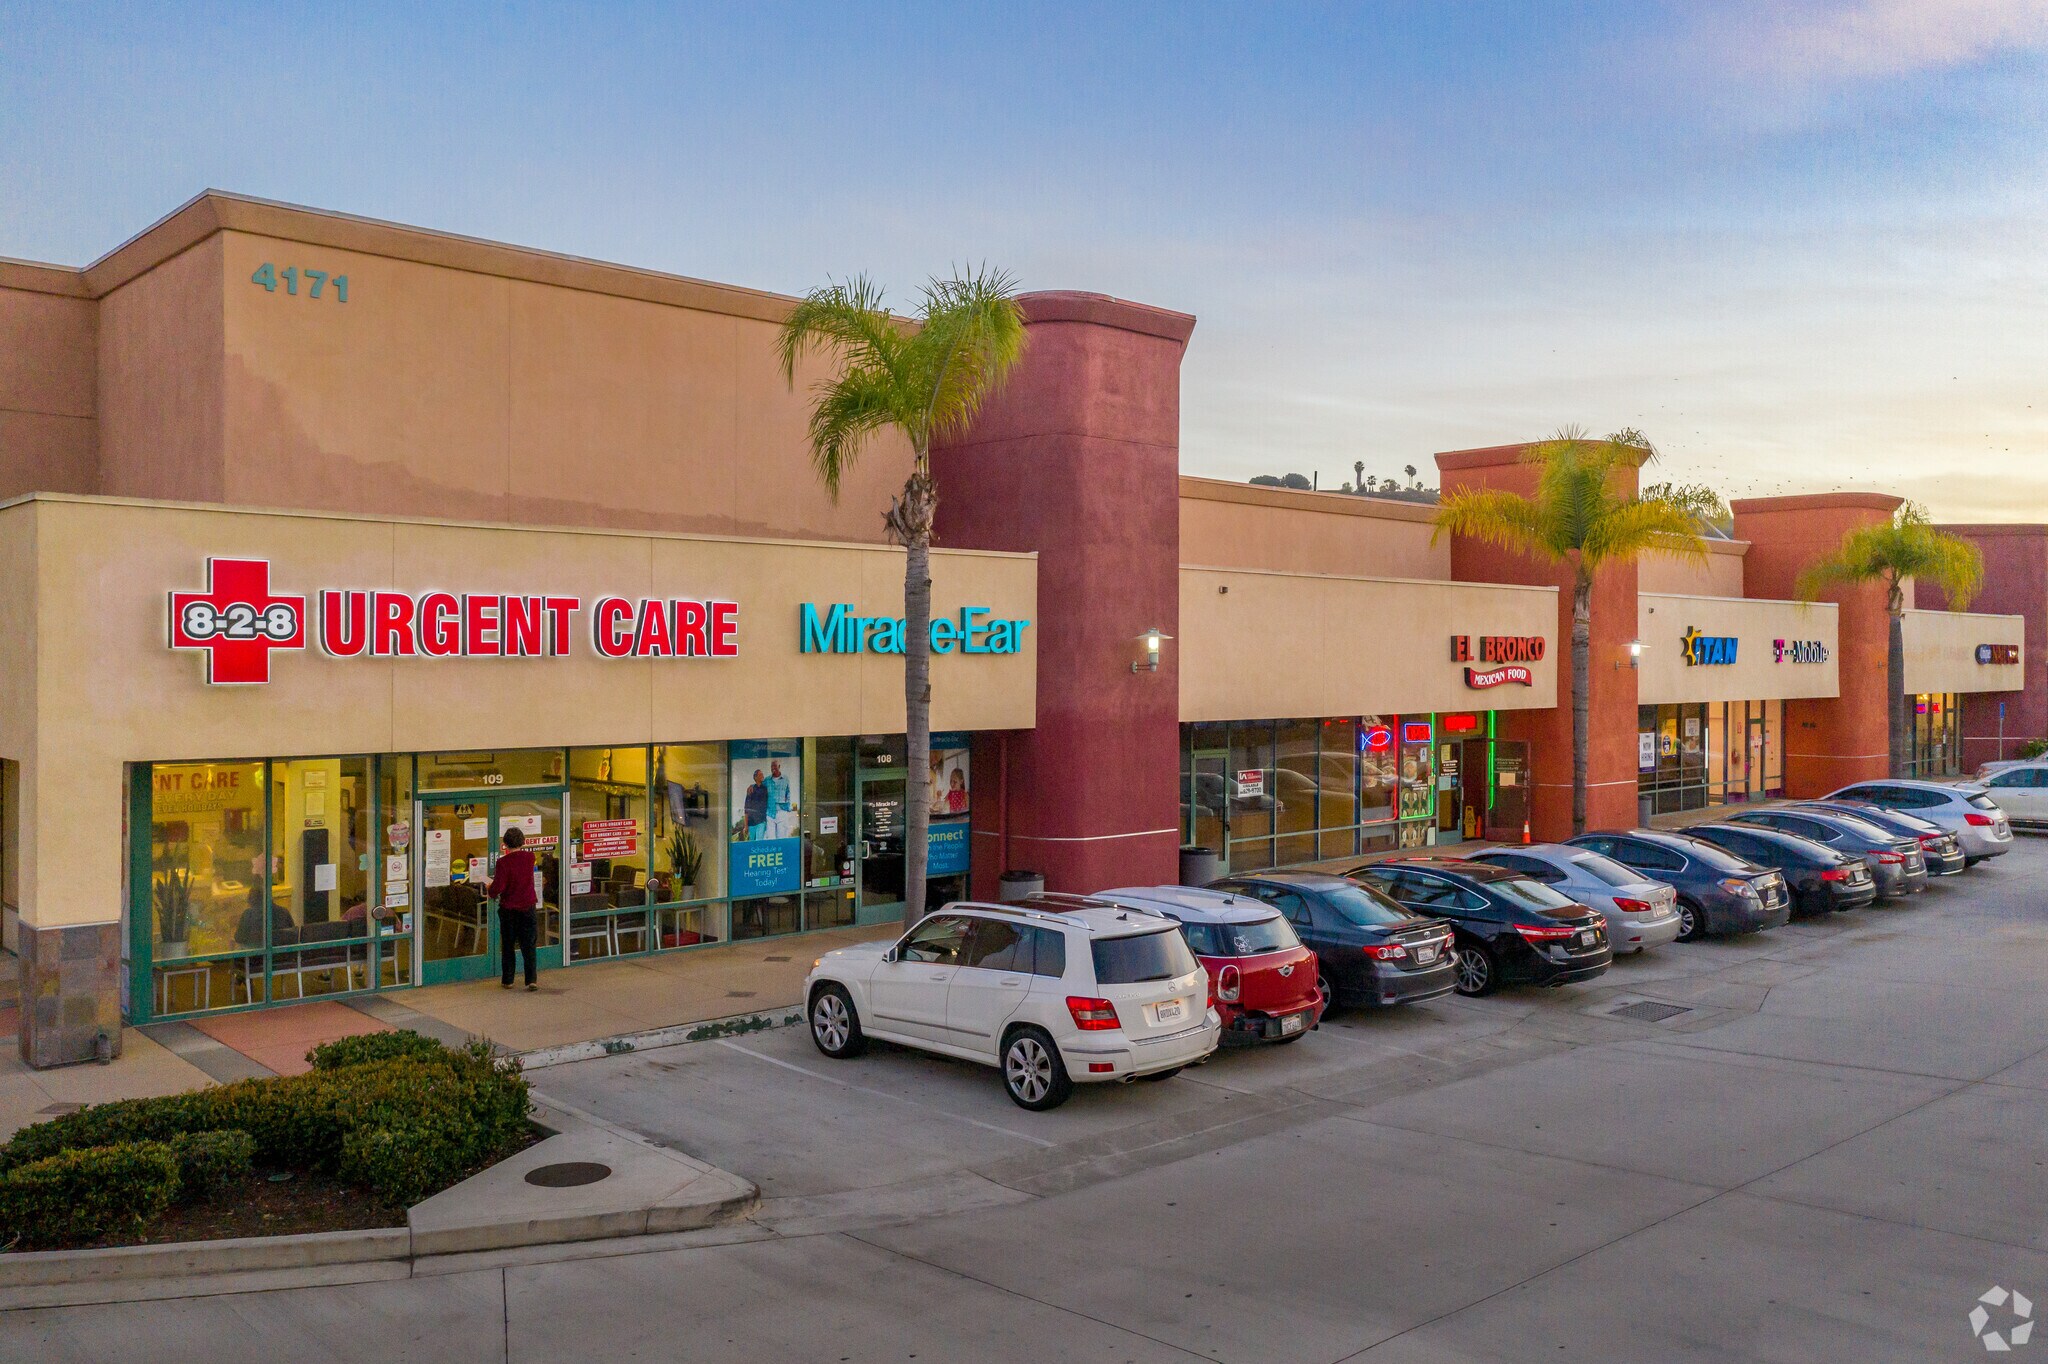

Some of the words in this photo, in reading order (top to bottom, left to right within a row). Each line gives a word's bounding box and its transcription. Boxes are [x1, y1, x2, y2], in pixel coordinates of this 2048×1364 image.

[251, 262, 349, 303] 4171
[184, 603, 295, 638] 8-2-8
[320, 590, 580, 657] URGENT
[594, 597, 738, 657] CARE
[802, 603, 1030, 654] Mirae-Ear
[1453, 635, 1474, 661] EL
[1482, 635, 1545, 663] BRONCO
[1474, 671, 1505, 685] MEXICAN
[1507, 669, 1526, 680] FOOD
[877, 754, 892, 763] 108
[482, 774, 504, 784] 109
[542, 836, 558, 844] CARE
[928, 829, 964, 843] onnect
[749, 853, 784, 868] FREE
[755, 877, 778, 888] Today!
